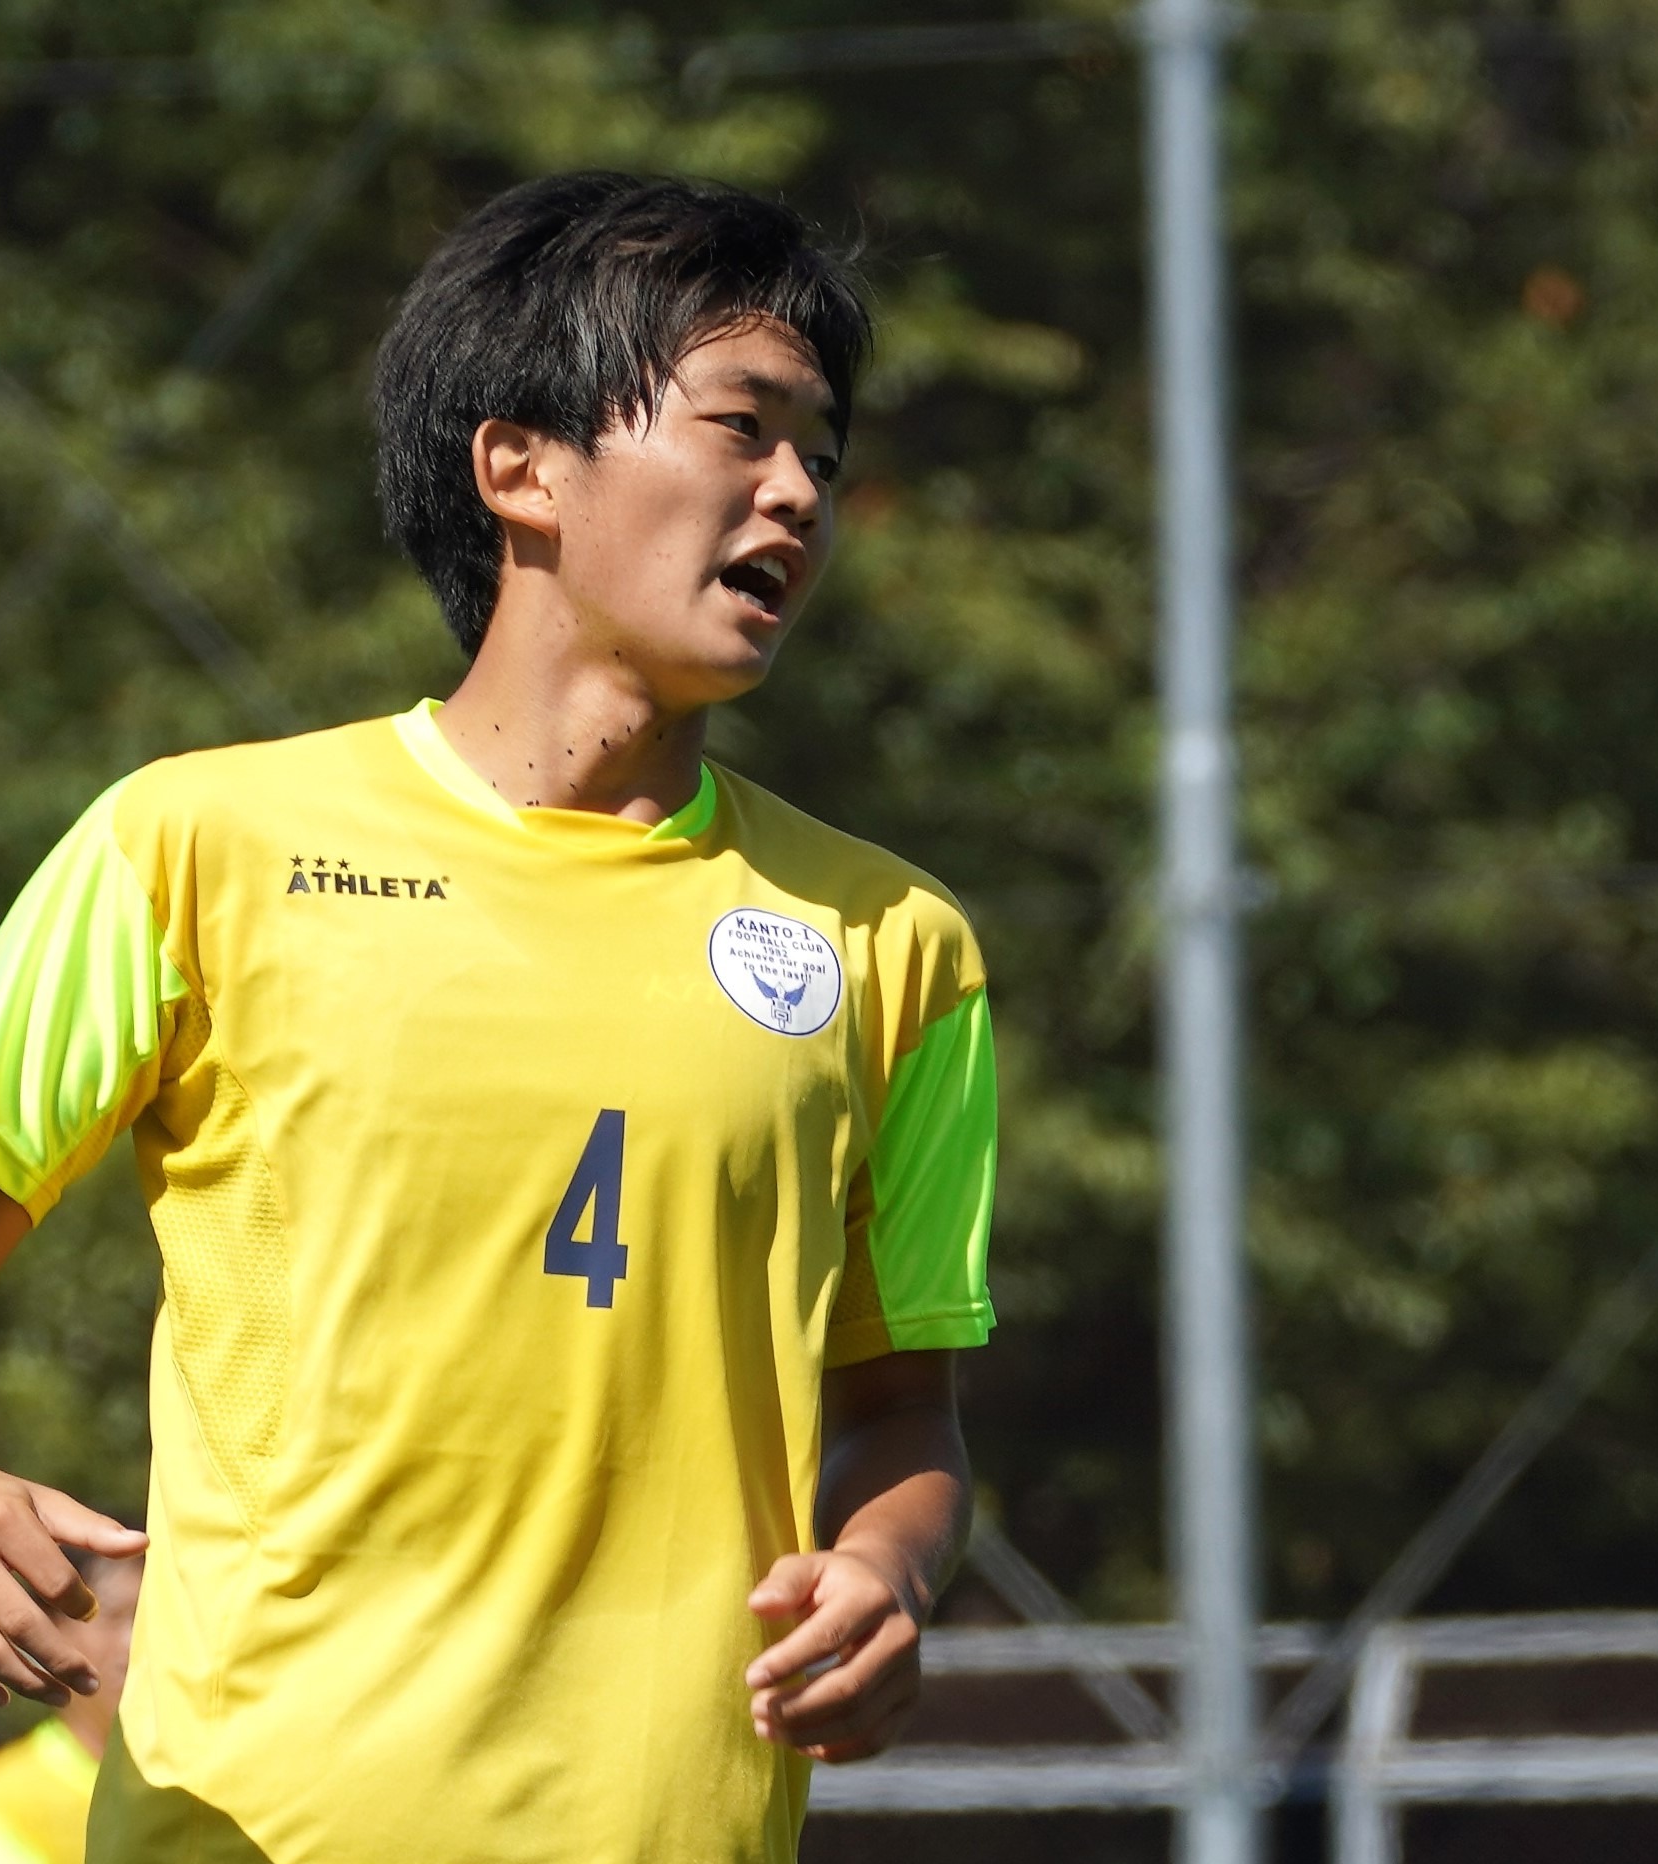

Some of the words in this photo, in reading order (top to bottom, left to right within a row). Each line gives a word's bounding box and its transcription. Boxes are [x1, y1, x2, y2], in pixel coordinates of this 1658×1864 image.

[286, 870, 447, 900] ATHLETA
[729, 930, 786, 948] FOOTBALL
[792, 942, 823, 953] CLUB
[730, 947, 774, 962] Achieve
[779, 958, 798, 968] our
[802, 962, 826, 975] goal
[743, 961, 755, 971] to
[760, 964, 778, 975] the
[543, 1107, 629, 1310] 4
